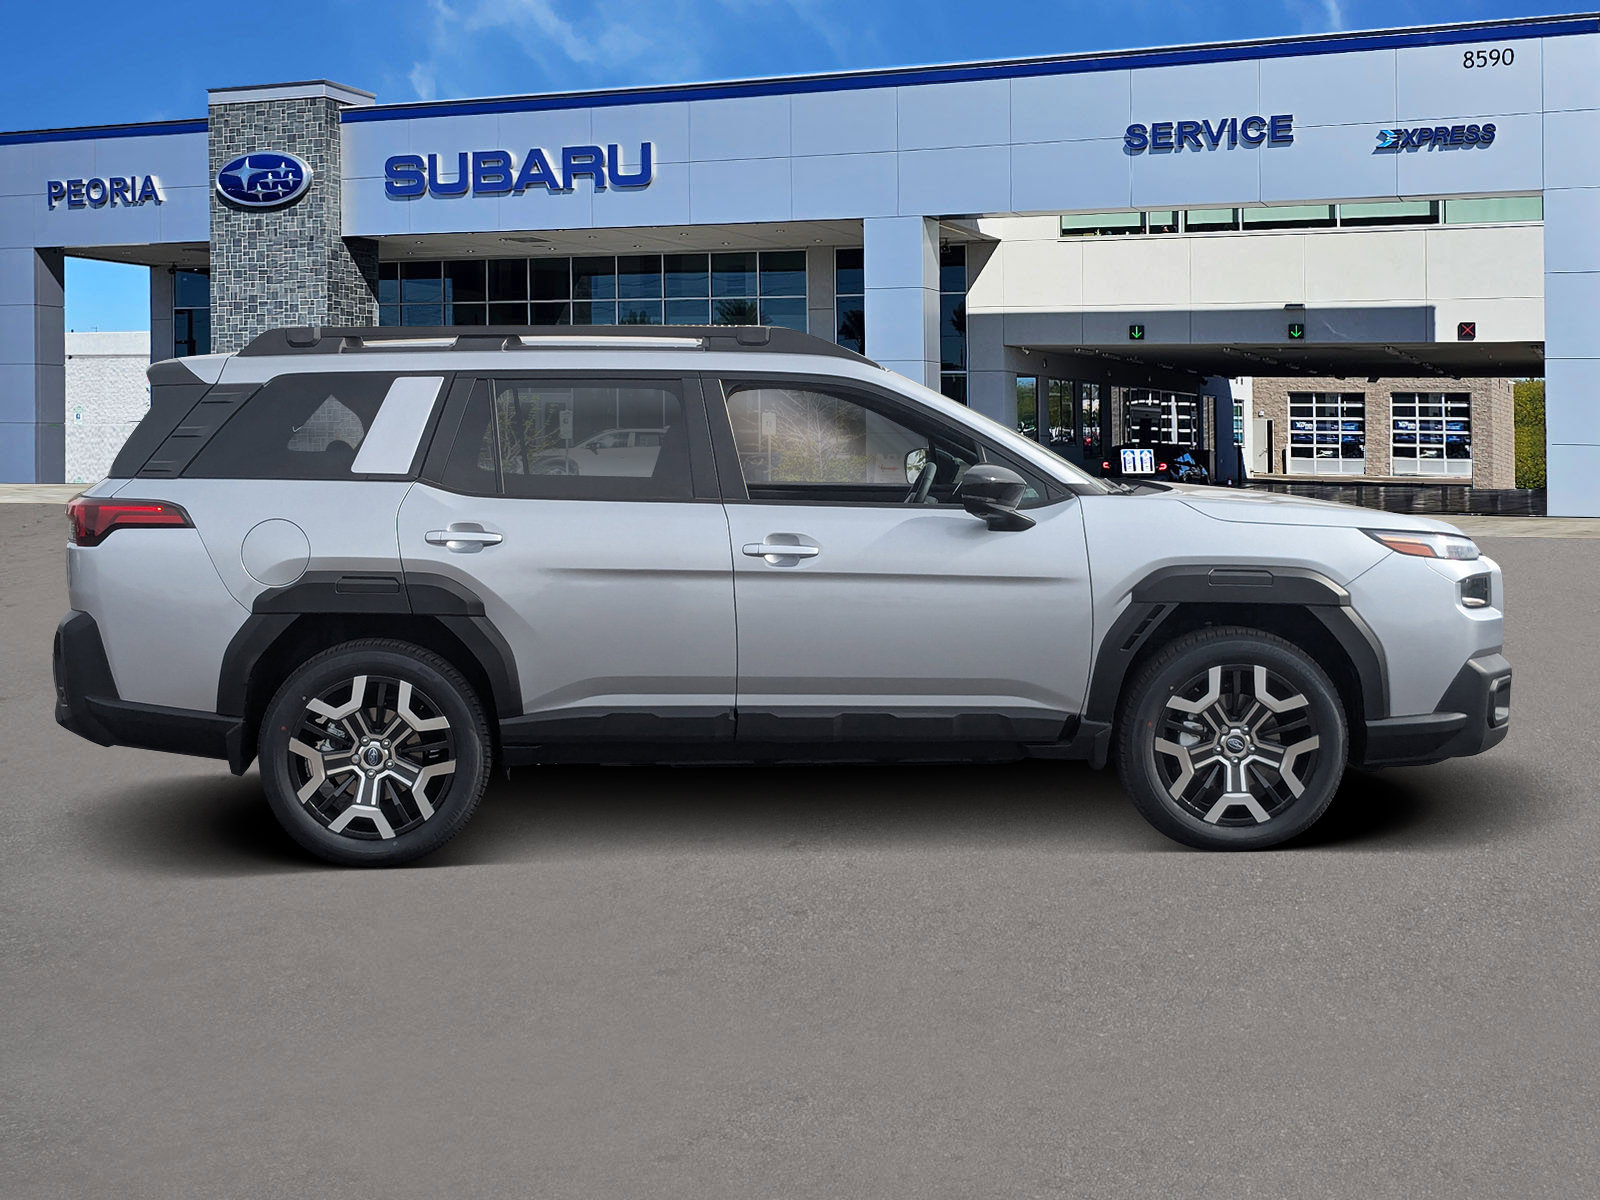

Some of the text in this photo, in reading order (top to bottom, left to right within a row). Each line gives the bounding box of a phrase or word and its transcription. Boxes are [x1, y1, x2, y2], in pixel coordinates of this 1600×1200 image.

[1463, 48, 1515, 69] 8590
[1124, 114, 1294, 152] SERVICE
[1376, 123, 1497, 149] EXPRESS
[47, 142, 652, 209] PEORIA SUBARU
